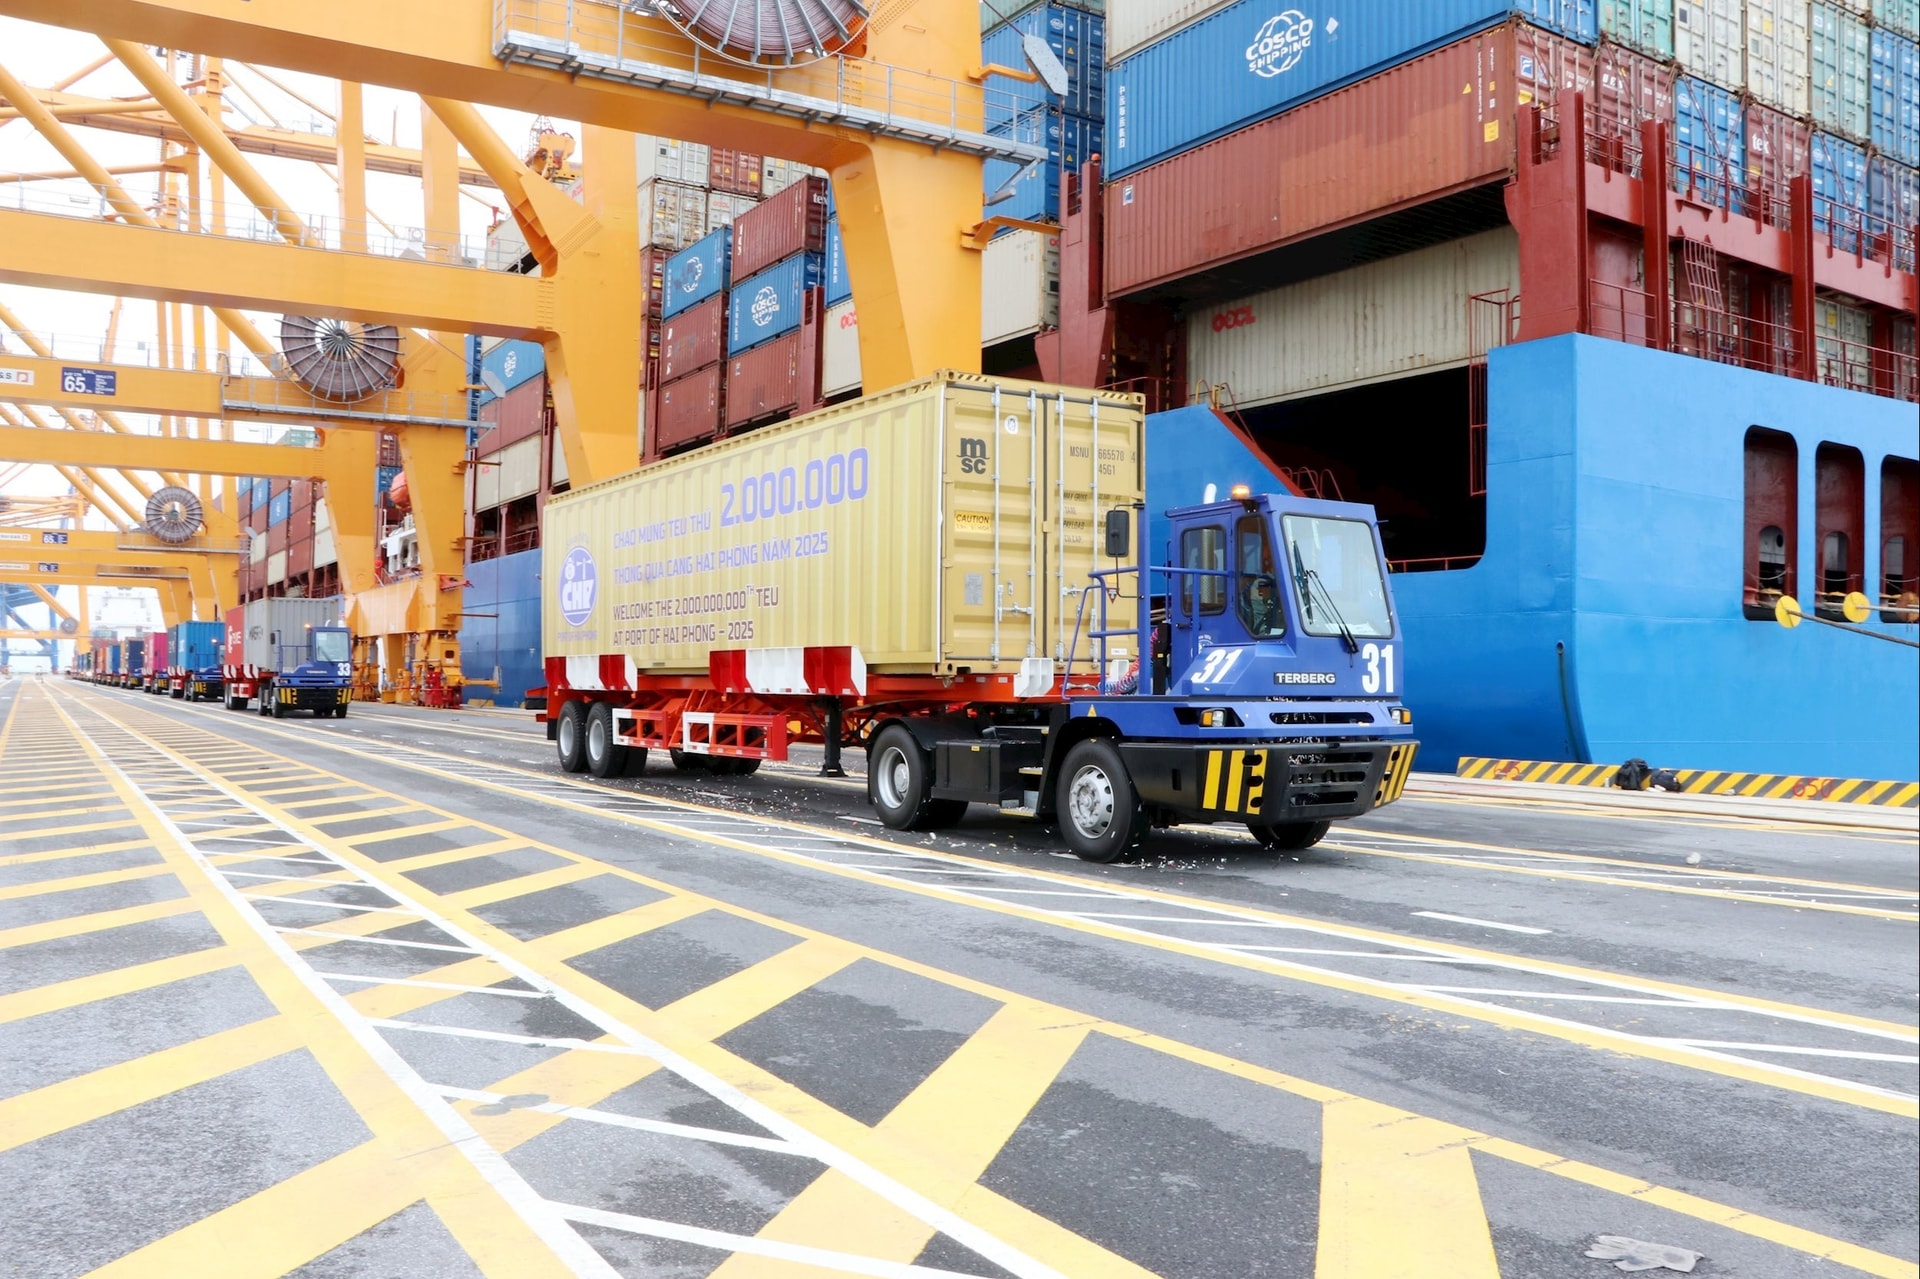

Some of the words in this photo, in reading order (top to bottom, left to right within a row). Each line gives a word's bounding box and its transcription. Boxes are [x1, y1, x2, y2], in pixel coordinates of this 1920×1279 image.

[1246, 18, 1313, 60] COSCO
[1249, 36, 1311, 72] SHIPPING
[64, 375, 86, 393] 65
[1069, 445, 1089, 459] MSNU
[1098, 463, 1116, 476] 45G1
[668, 516, 688, 538] TEU
[720, 447, 869, 528] 2.000.000
[956, 513, 990, 525] CAUTION
[645, 561, 664, 584] QUA
[795, 531, 829, 558] 2025
[613, 602, 654, 621] WELCOME
[656, 599, 673, 617] THE
[756, 586, 779, 607] TEU
[613, 631, 624, 646] AT
[625, 628, 647, 645] PORT
[649, 627, 661, 645] OF
[663, 626, 680, 644] HAI
[682, 623, 716, 643] PHONG
[728, 620, 754, 641] 2025
[337, 662, 351, 677] 33
[1190, 648, 1243, 684] 31
[1276, 672, 1336, 684] TERBERG
[1361, 643, 1394, 694] 31
[1792, 777, 1834, 799] 650
